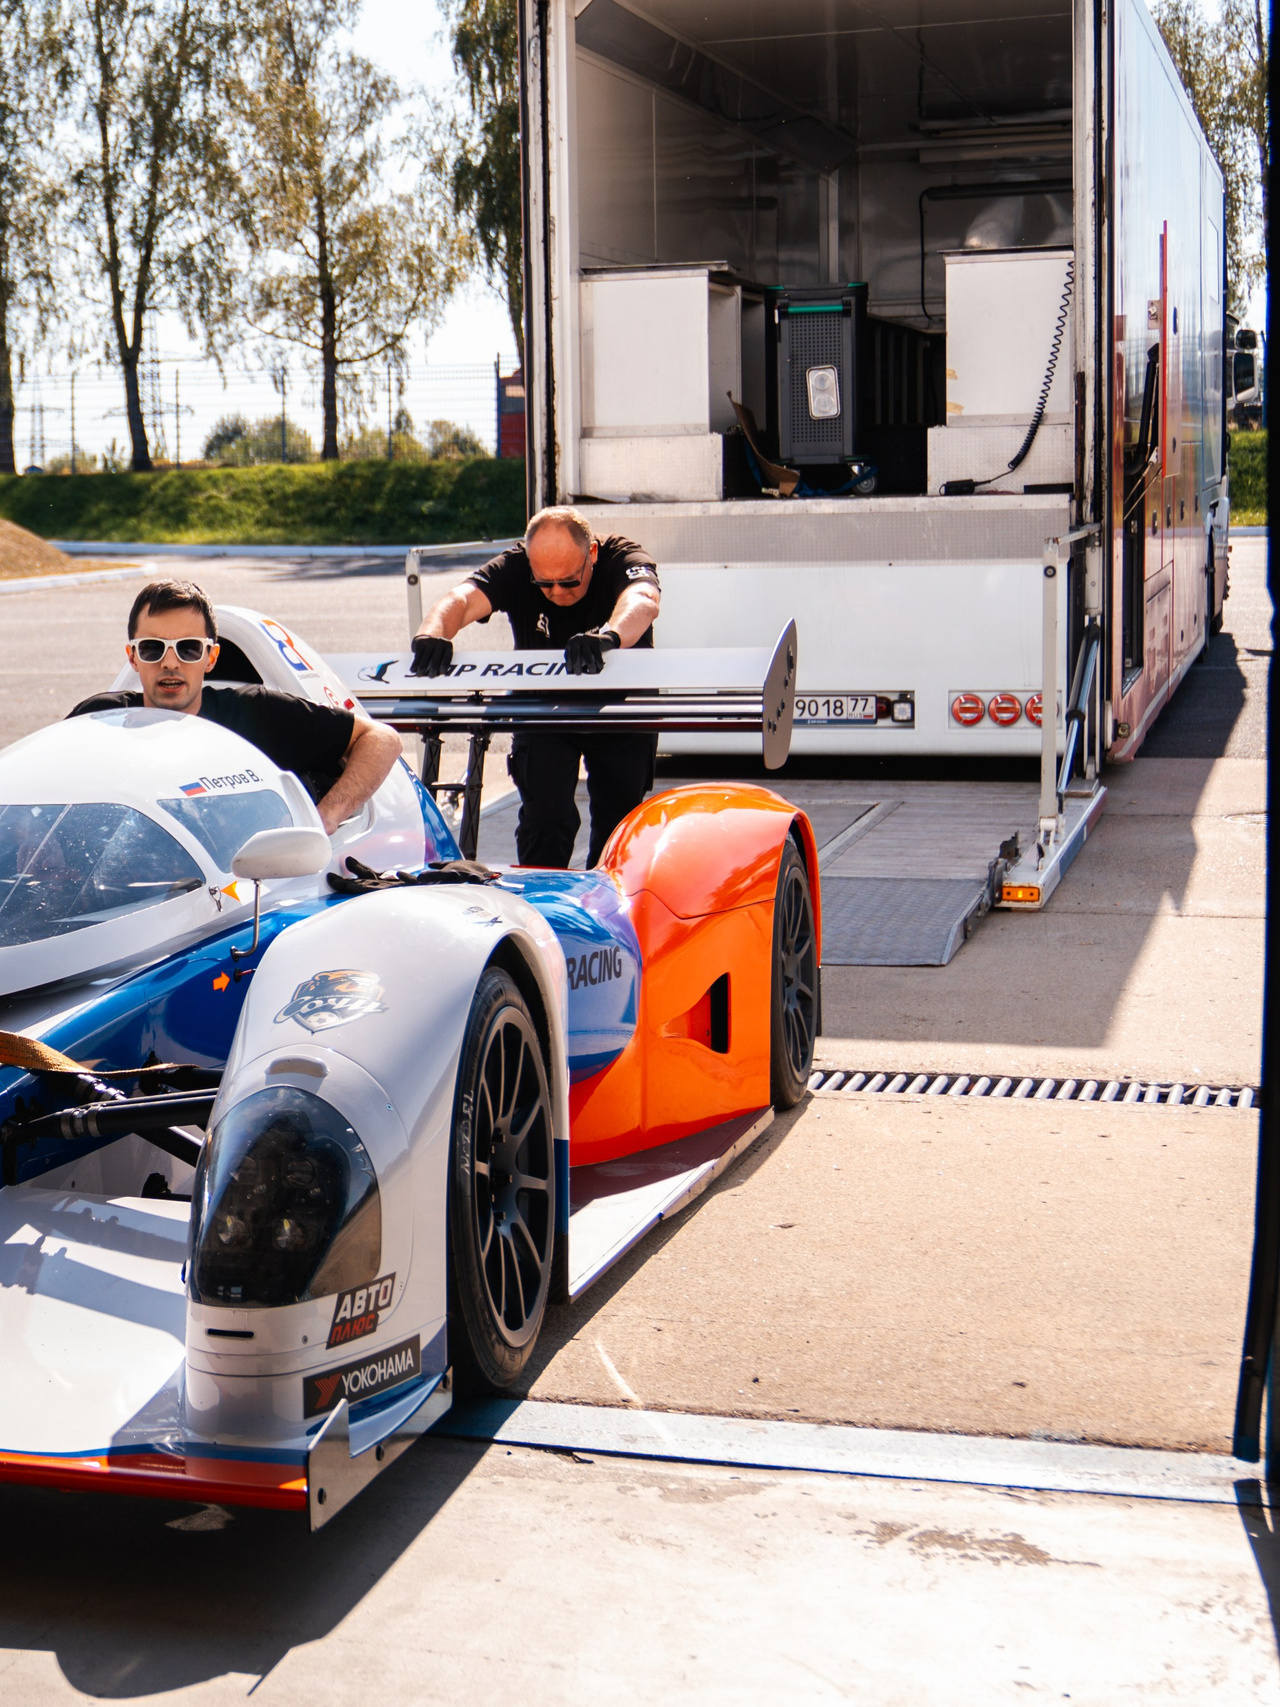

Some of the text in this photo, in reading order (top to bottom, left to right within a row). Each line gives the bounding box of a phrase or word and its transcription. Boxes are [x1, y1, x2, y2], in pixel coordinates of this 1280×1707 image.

[795, 698, 869, 717] 9018 77
[199, 769, 264, 789] Петров В.
[566, 945, 622, 990] RACING
[335, 1278, 393, 1323] АВТО
[329, 1313, 376, 1344] ПЛЮС
[342, 1348, 414, 1396] YOKOHAMA
